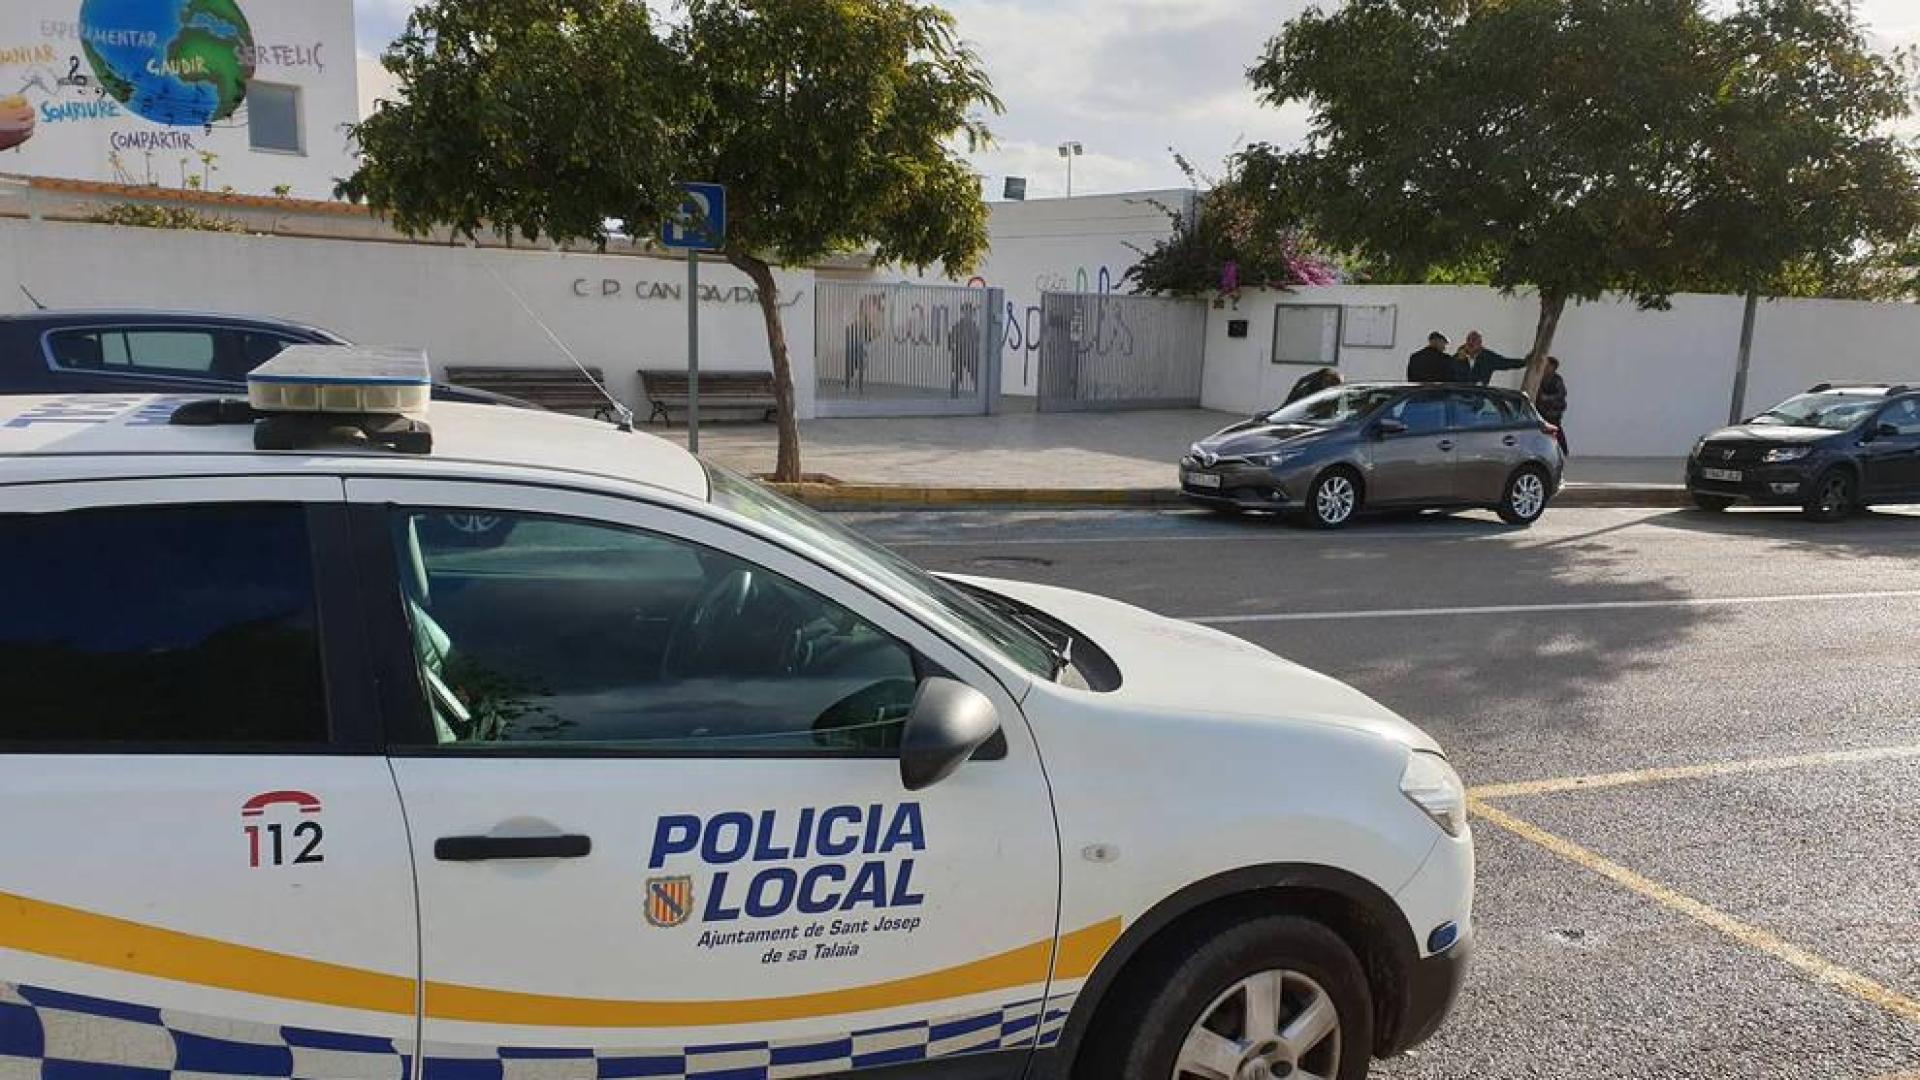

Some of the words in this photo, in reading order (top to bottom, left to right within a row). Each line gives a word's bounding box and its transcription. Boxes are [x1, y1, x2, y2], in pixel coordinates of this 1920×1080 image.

[110, 131, 194, 150] COMPARTIR
[635, 280, 681, 300] CAN
[243, 821, 325, 867] 112
[648, 802, 926, 869] POLICIA
[702, 858, 925, 921] LOCAL
[698, 925, 800, 949] Ajuntament
[804, 923, 825, 938] de
[829, 918, 868, 936] Sant
[873, 916, 920, 933] Josep
[761, 948, 783, 964] de
[787, 949, 808, 962] sa
[815, 941, 860, 961] Talaia
